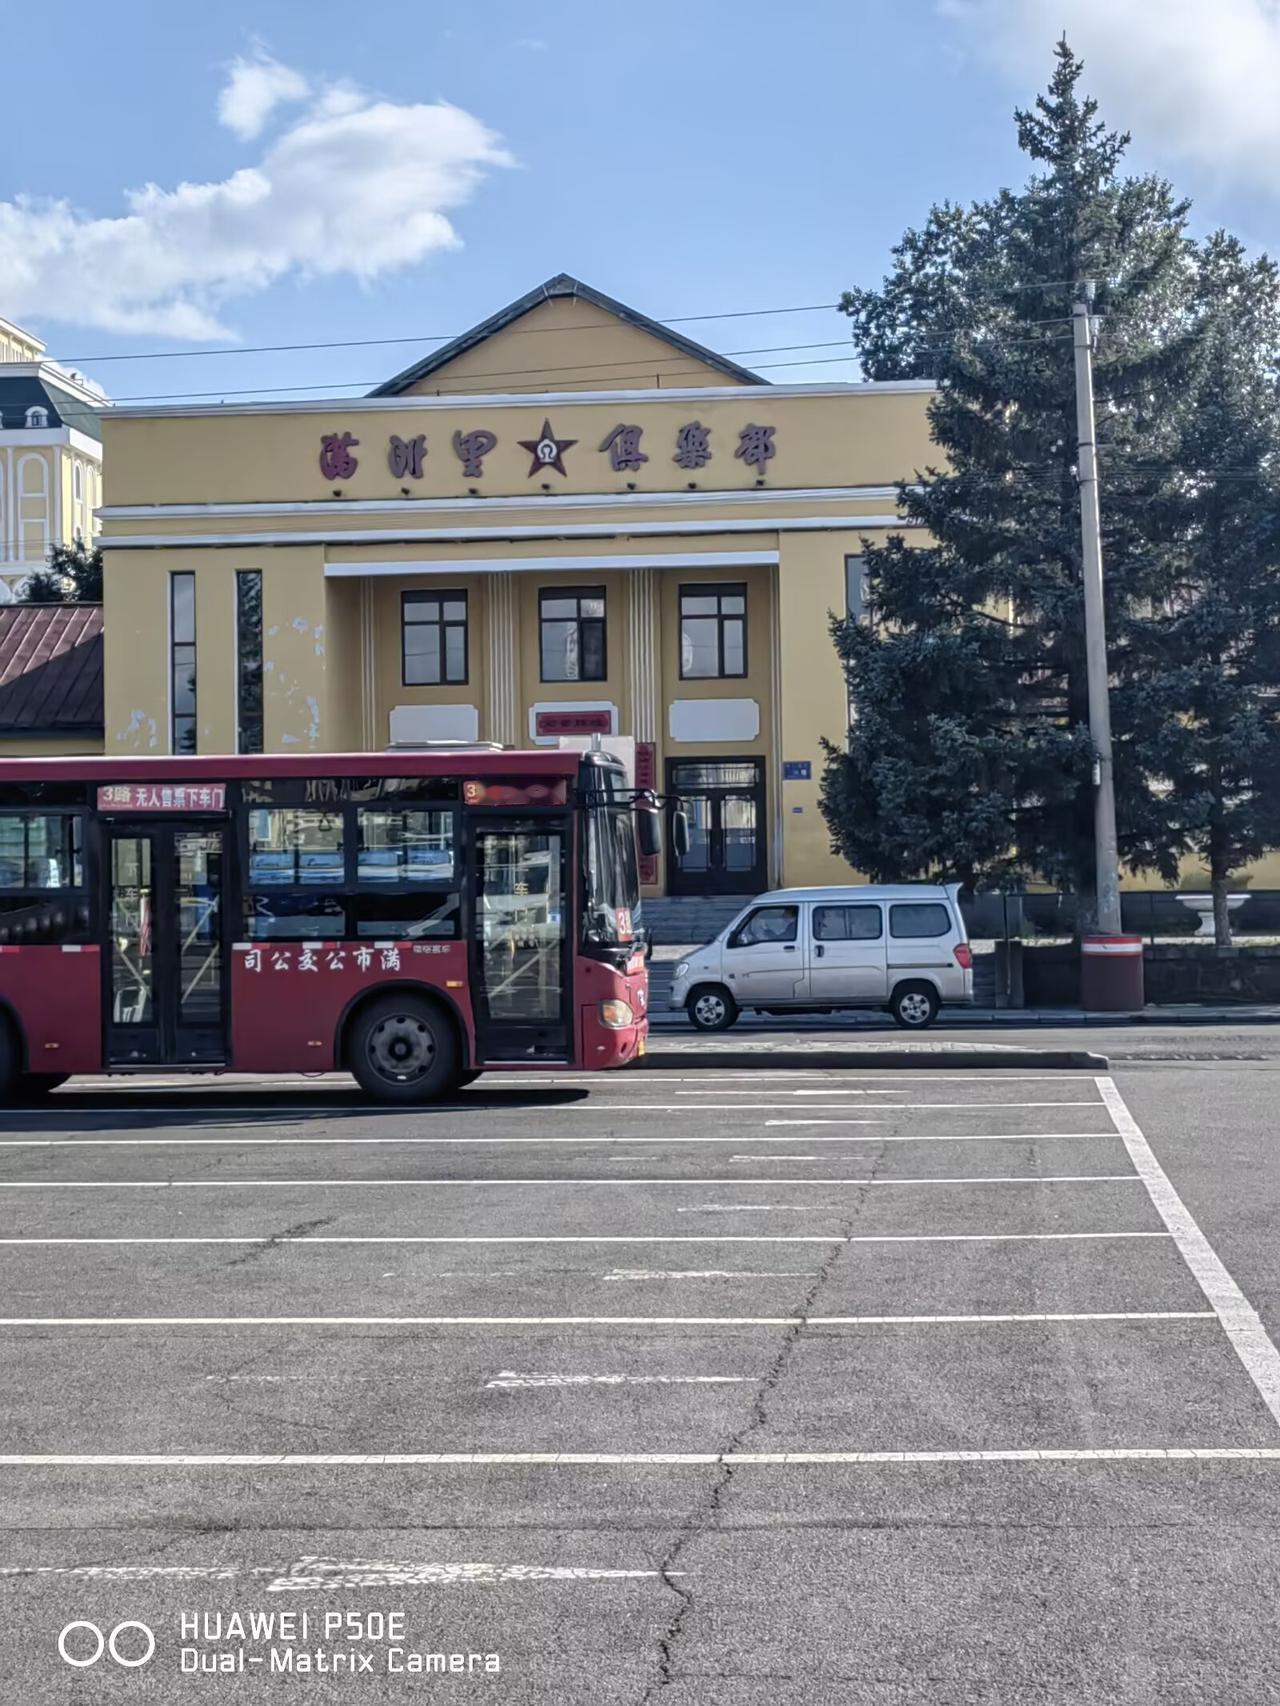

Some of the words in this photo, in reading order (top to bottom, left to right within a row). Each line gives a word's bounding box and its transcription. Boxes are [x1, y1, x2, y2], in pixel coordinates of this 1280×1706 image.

[136, 786, 224, 809] 无人售票下车门
